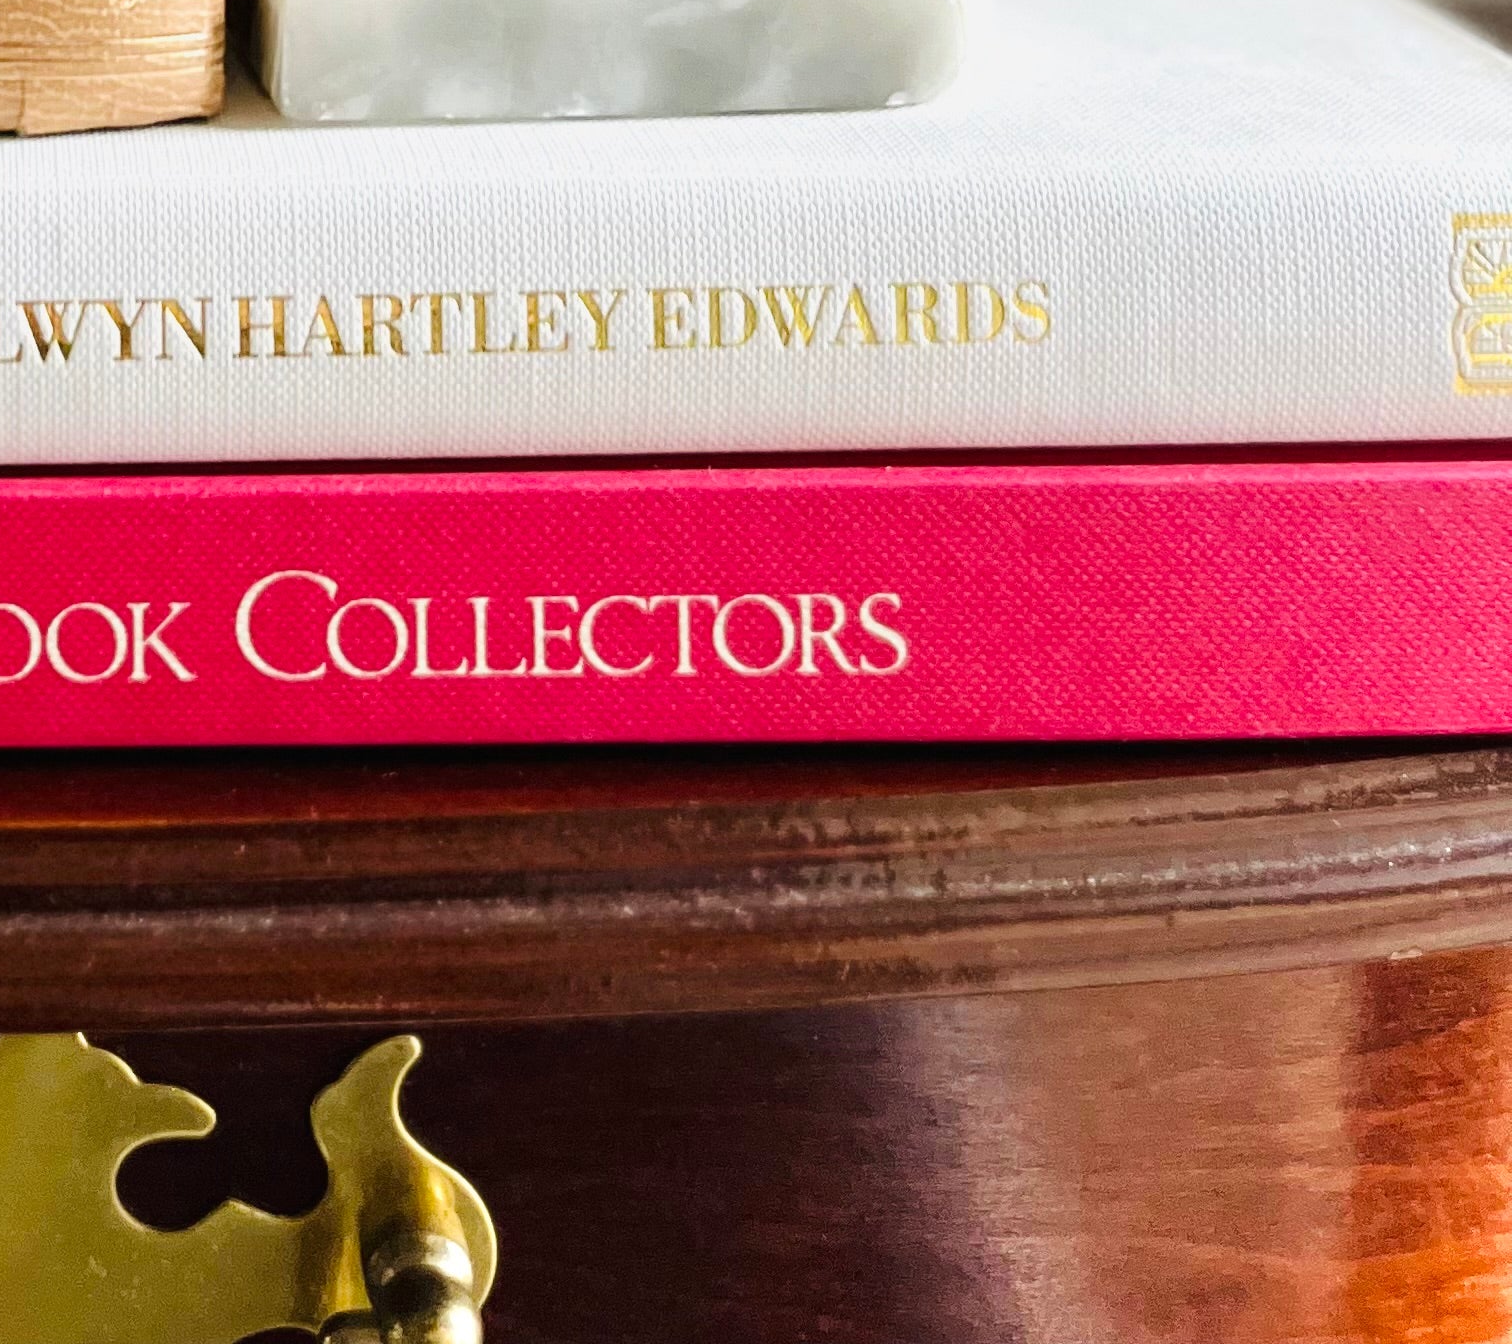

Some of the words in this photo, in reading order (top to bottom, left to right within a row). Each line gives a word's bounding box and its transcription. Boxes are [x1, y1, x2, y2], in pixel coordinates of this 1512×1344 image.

[233, 291, 625, 359] HARTLEY
[646, 282, 1052, 351] EDWARDS
[236, 571, 907, 680] COLLECTORS
